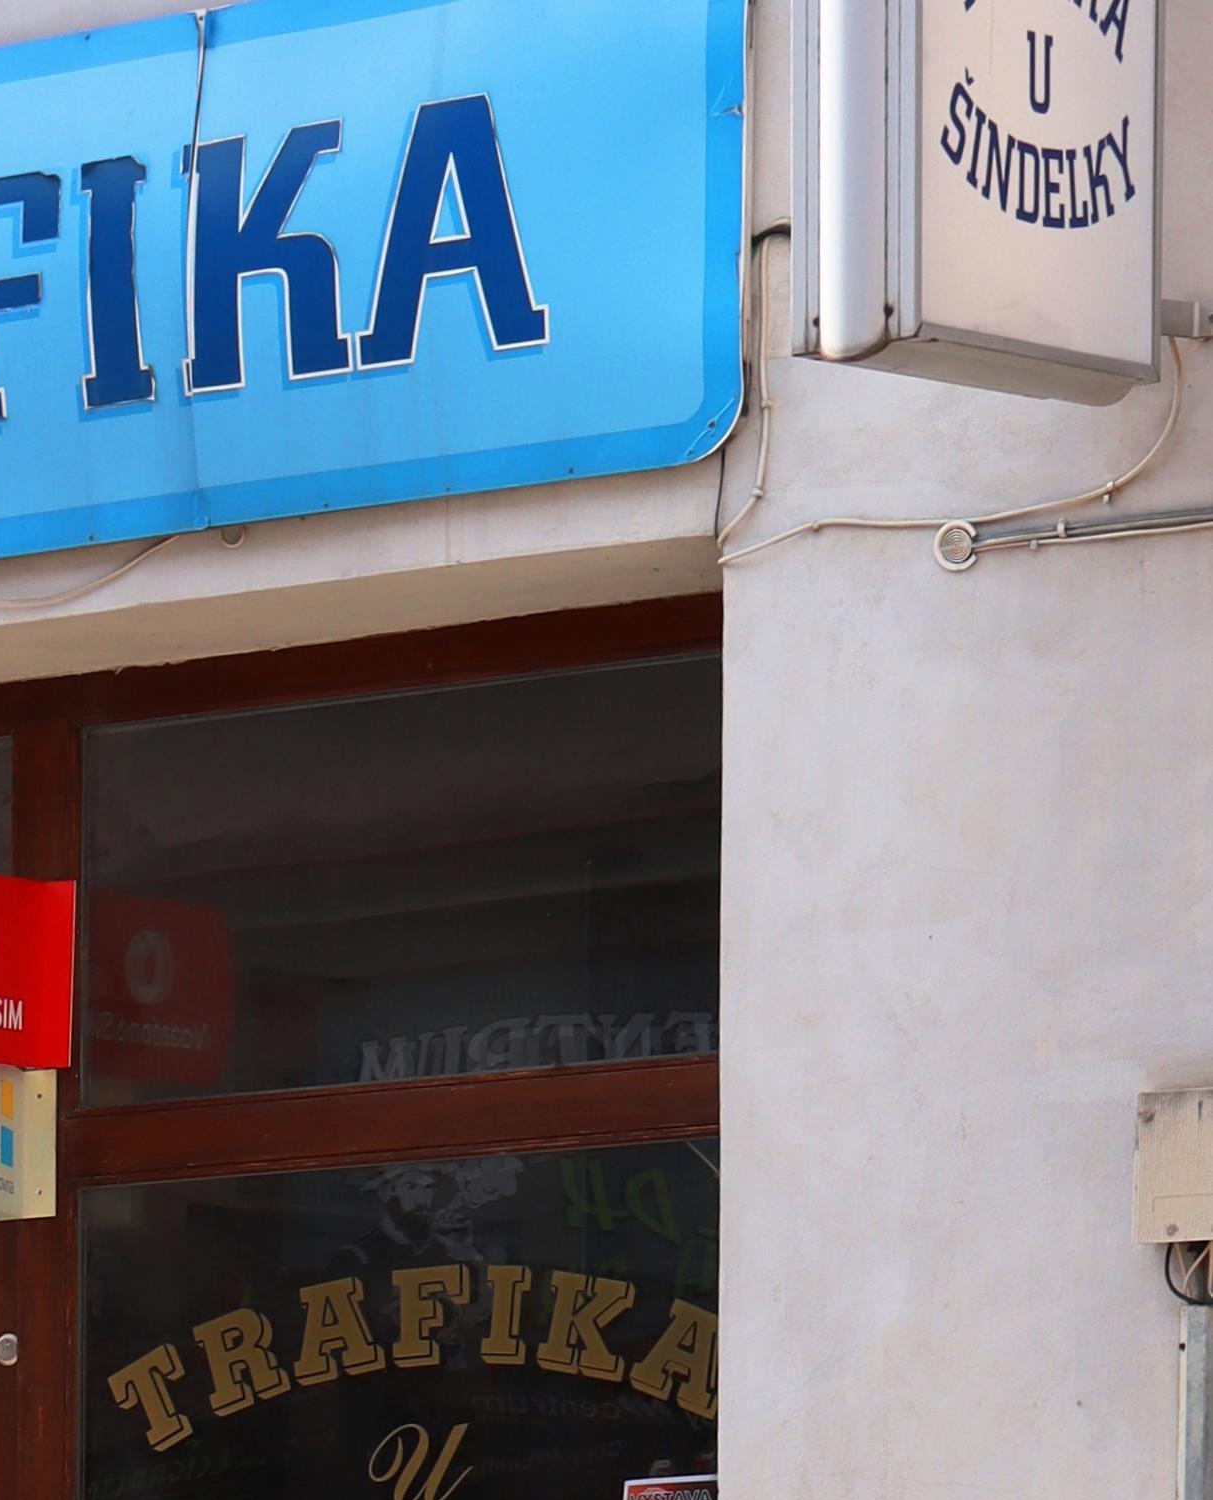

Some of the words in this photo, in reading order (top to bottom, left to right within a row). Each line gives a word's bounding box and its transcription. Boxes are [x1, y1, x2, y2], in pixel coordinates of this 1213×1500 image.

[940, 67, 1135, 229] ŠINDELKY
[1027, 31, 1053, 114] U
[107, 1264, 719, 1452] TRAFIKA
